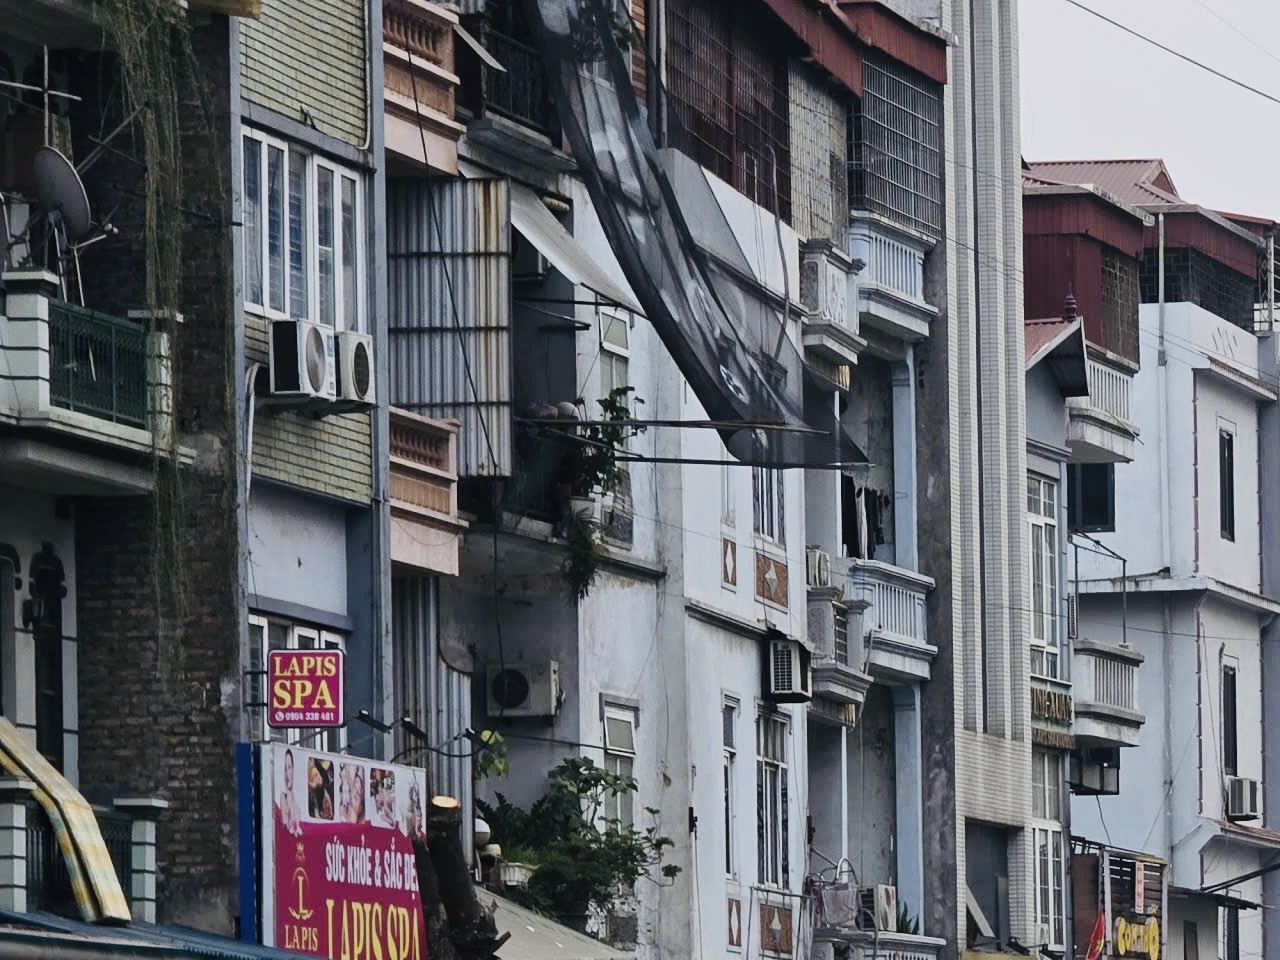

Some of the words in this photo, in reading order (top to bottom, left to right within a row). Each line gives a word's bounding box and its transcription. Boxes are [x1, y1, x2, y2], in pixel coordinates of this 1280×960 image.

[274, 656, 336, 676] LAPIS
[273, 680, 336, 709] SPA
[325, 834, 345, 883] SỨC
[347, 833, 372, 886] KHỎE
[374, 849, 382, 887] &
[384, 837, 402, 889] SẮC
[404, 853, 419, 900] ĐẸ
[285, 925, 318, 951] LAPIS
